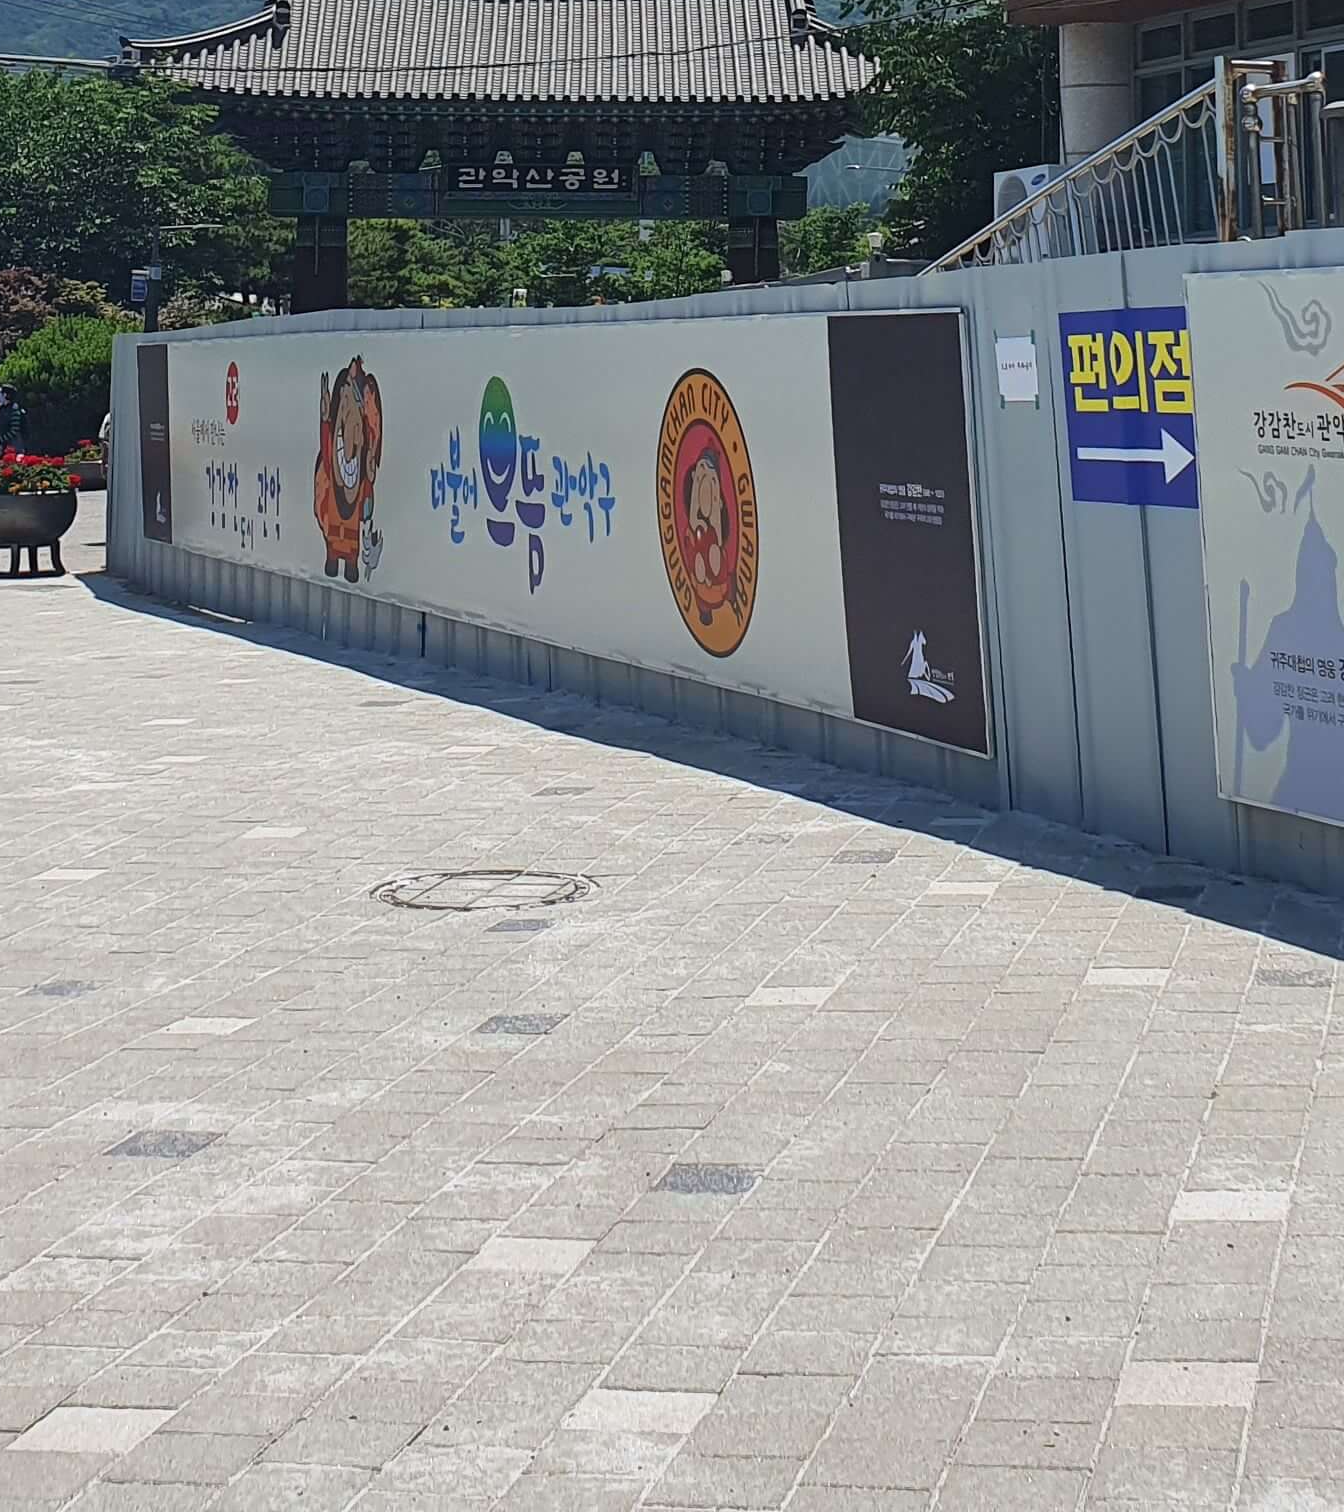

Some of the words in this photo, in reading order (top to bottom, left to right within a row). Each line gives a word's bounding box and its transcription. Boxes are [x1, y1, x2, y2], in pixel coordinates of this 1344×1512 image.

[457, 167, 620, 190] 관악산공원
[1067, 329, 1195, 414] 편의점
[257, 464, 281, 541] 관악
[430, 425, 478, 545] 더불어
[551, 451, 616, 544] 관악구
[659, 382, 697, 614] GANGGAMCHAN
[701, 382, 729, 432] CITY
[729, 472, 755, 628] GWANAK
[1270, 651, 1315, 674] 귀주대첩의
[1317, 658, 1336, 679] 영웅
